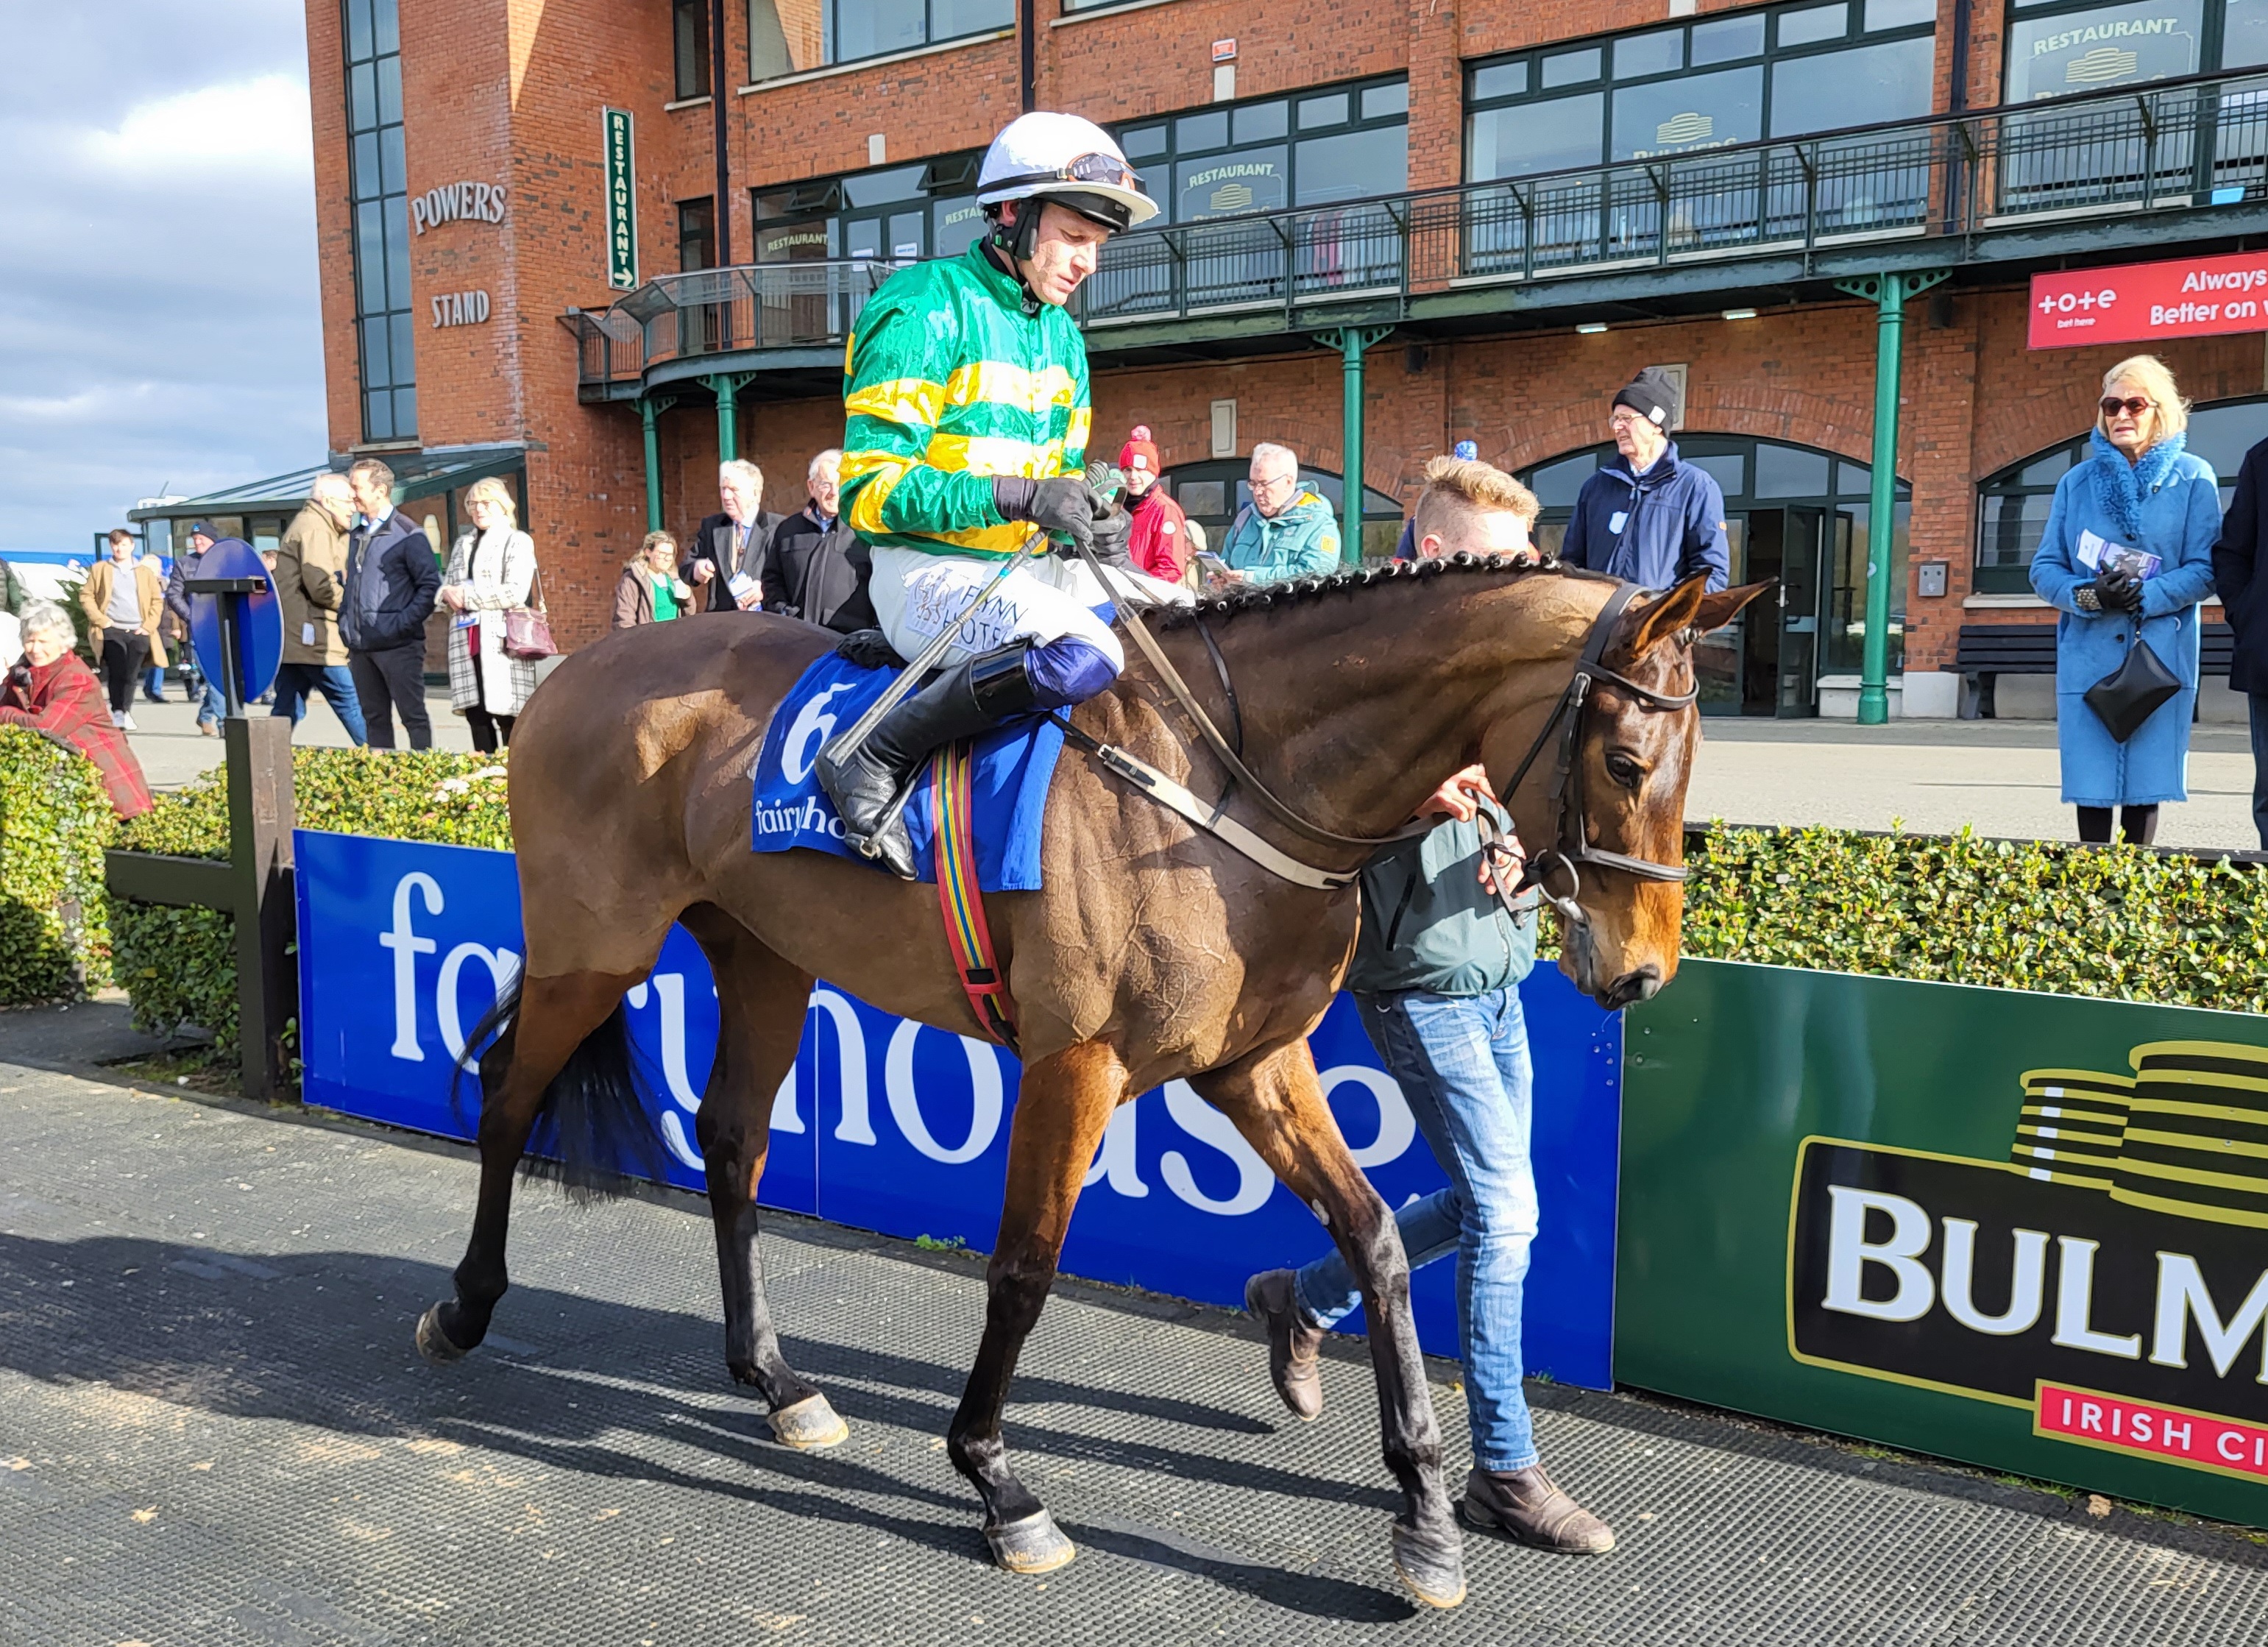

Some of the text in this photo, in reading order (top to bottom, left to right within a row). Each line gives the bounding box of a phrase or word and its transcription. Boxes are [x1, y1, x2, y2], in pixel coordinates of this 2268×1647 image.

[2033, 18, 2178, 56] RESTAURANT
[613, 115, 629, 266] RESTAURANT
[1188, 163, 1275, 188] RESTAURANT
[411, 181, 507, 236] POWERS
[768, 232, 830, 253] RESTAURANT
[2180, 268, 2268, 293] Always
[431, 289, 490, 328] STAND
[2150, 301, 2220, 326] Better
[2224, 300, 2257, 319] on
[781, 682, 857, 786] 6
[2061, 1397, 2265, 1467] IRISH CI
